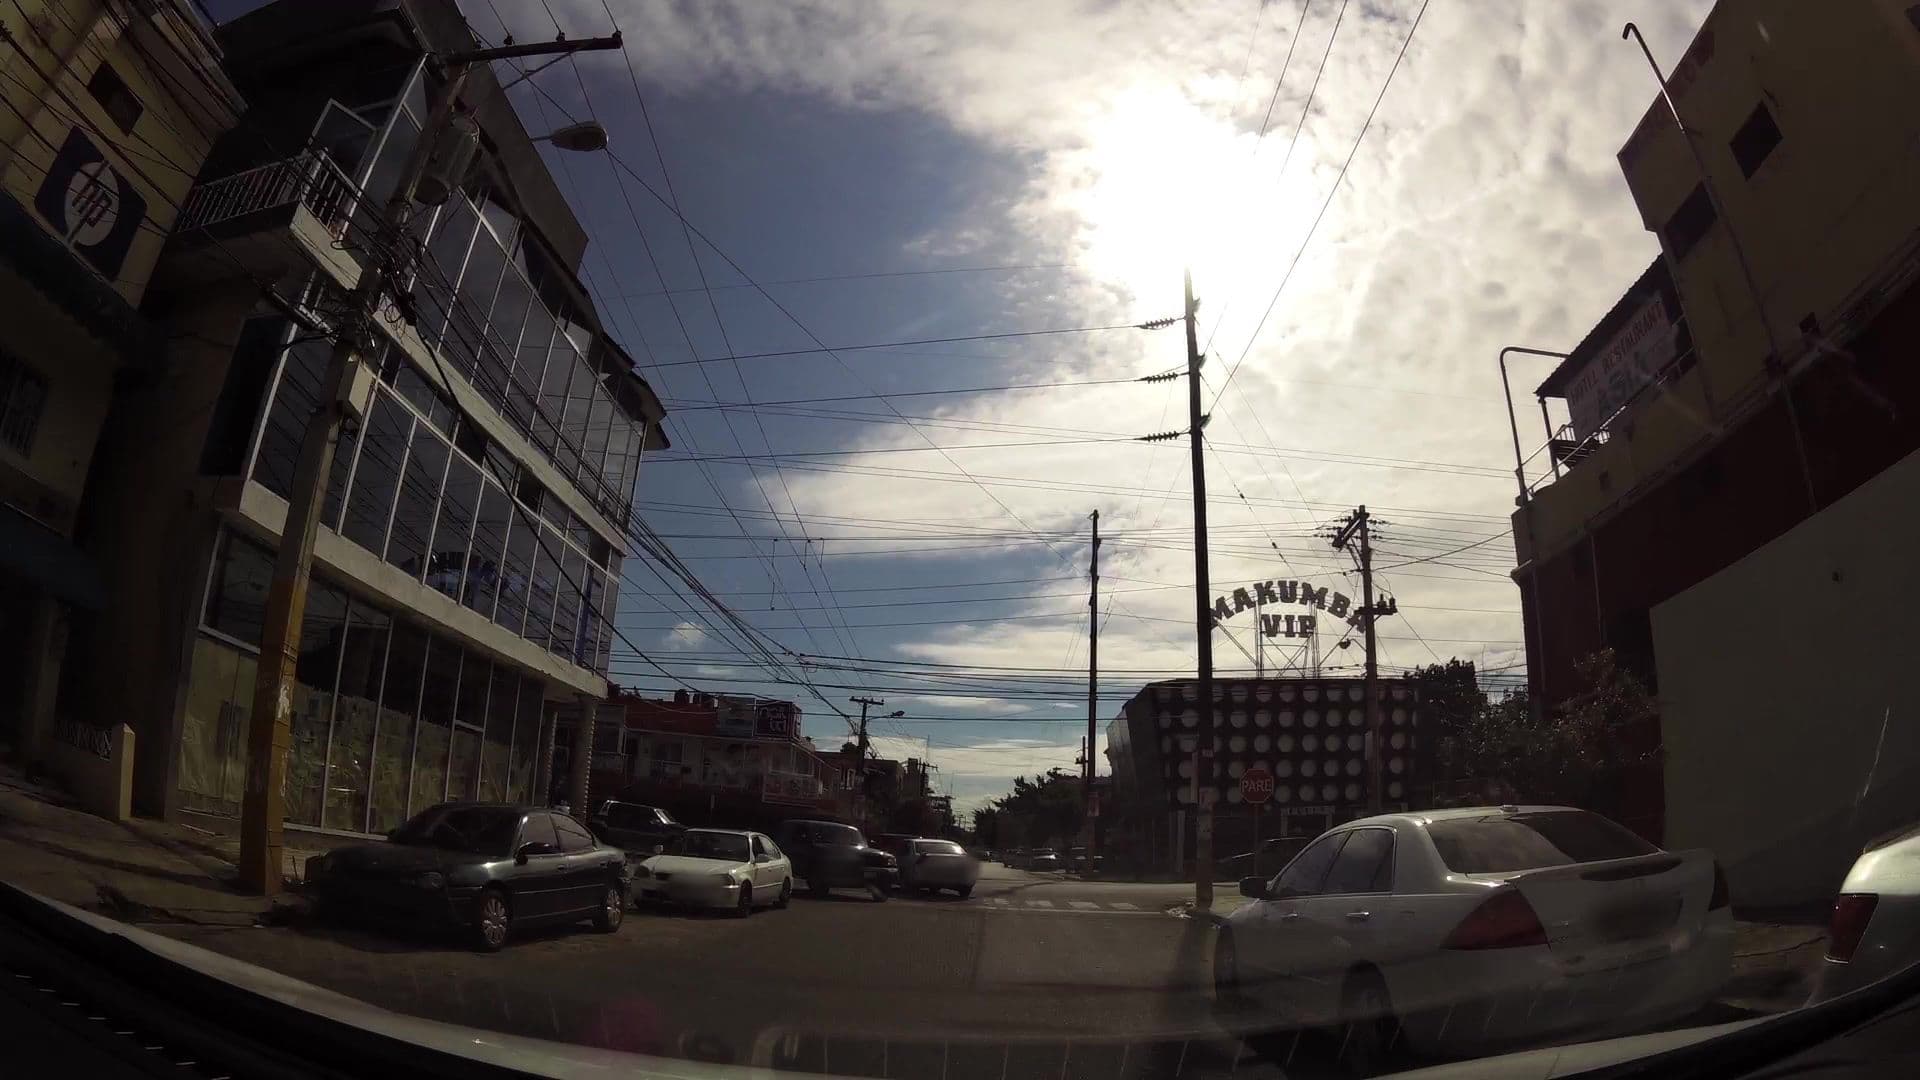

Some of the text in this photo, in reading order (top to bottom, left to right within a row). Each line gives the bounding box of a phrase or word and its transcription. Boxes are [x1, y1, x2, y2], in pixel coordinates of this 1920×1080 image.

[1602, 303, 1664, 374] RESTAURANT
[1209, 580, 1367, 633] MAKUMBA
[1260, 614, 1316, 638] VIP
[1241, 778, 1272, 793] PARE
